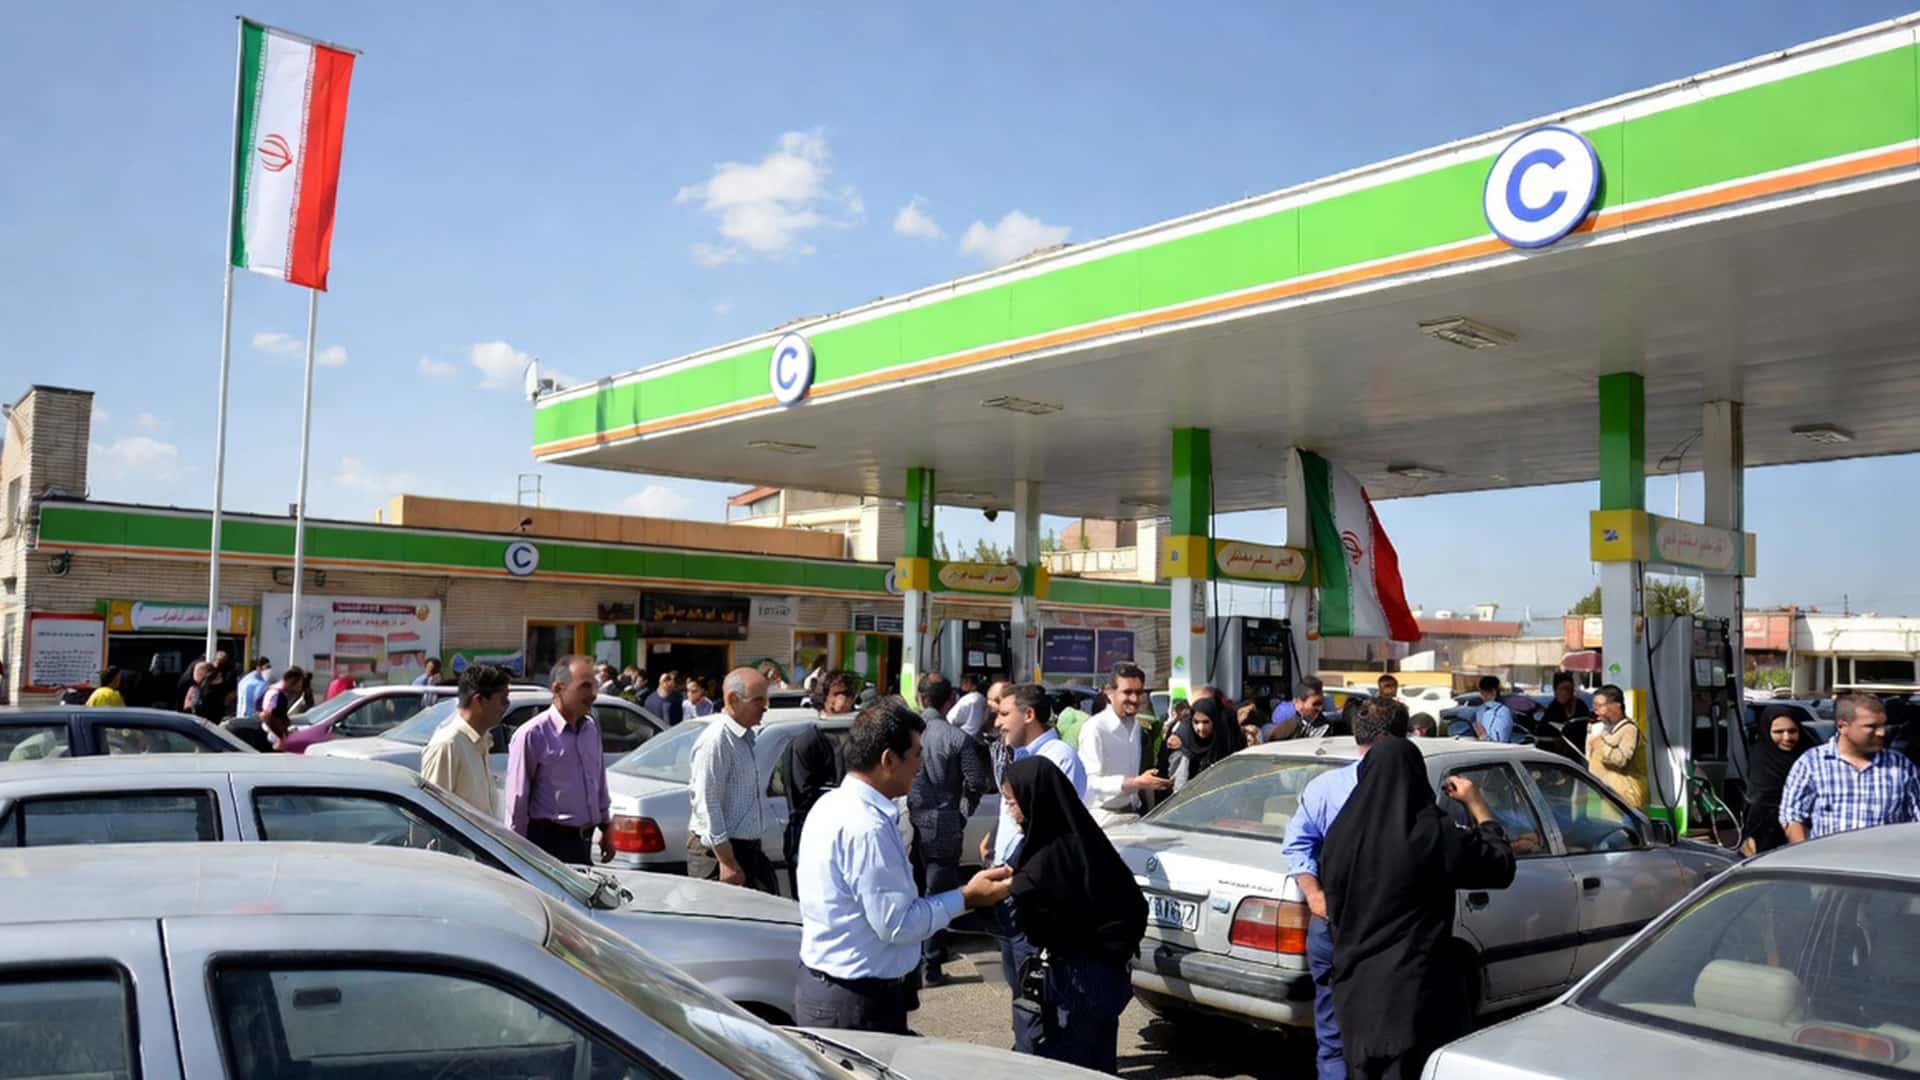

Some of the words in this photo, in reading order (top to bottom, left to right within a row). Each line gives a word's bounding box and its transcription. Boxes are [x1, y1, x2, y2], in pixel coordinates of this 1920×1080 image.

[1505, 148, 1568, 223] C
[776, 347, 798, 390] C
[512, 546, 532, 569] C
